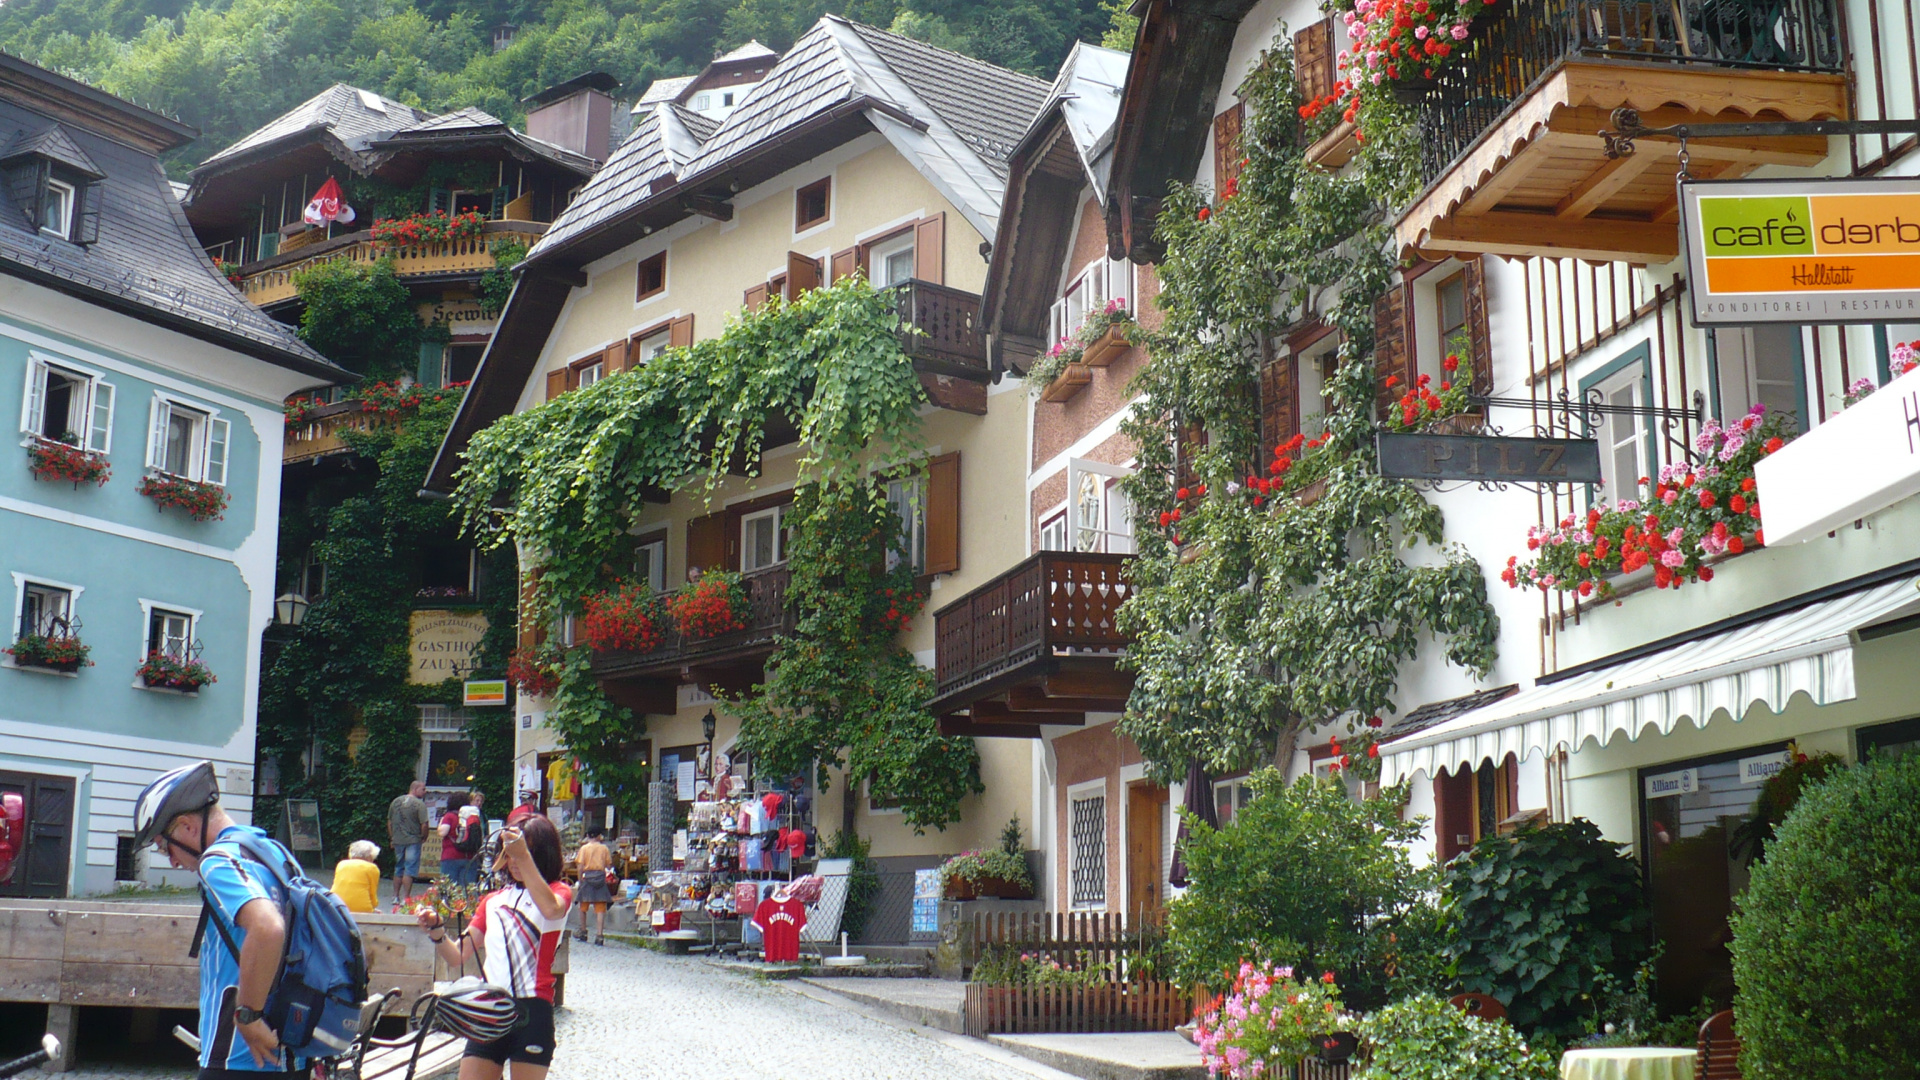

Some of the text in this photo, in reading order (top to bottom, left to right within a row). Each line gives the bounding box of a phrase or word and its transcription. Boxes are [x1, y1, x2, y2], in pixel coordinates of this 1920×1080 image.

[1712, 206, 1806, 247] café
[1791, 263, 1856, 286] Hallstatt
[1707, 299, 1915, 314] KONDITOREI RESTAUR
[1419, 439, 1568, 477] PILZ
[418, 640, 480, 652] GASTHO
[1747, 761, 1781, 778] Allianz
[1651, 778, 1680, 793] Allianz
[768, 911, 795, 926] AUSTRIA
